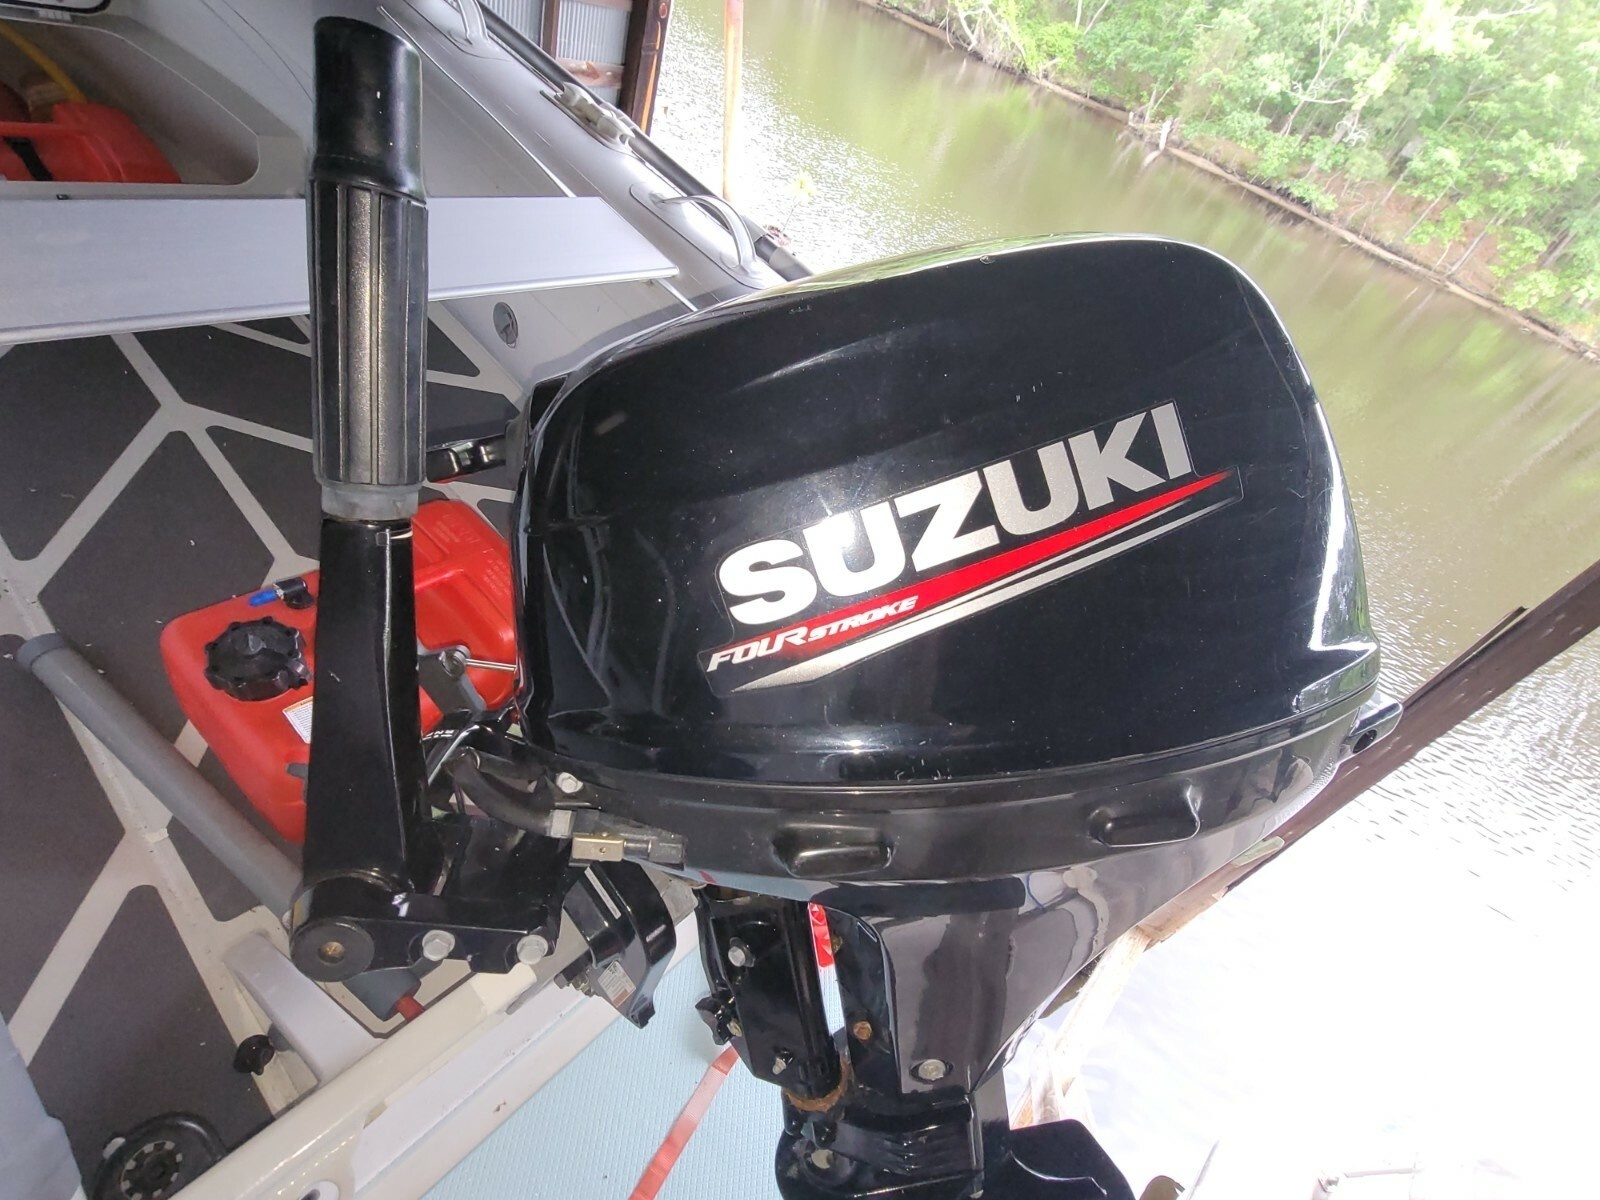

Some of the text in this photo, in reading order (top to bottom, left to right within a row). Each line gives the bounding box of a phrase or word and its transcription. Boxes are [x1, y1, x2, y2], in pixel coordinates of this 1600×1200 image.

[718, 402, 1192, 625] SUZUKI
[706, 596, 919, 672] FOUR STROKE
